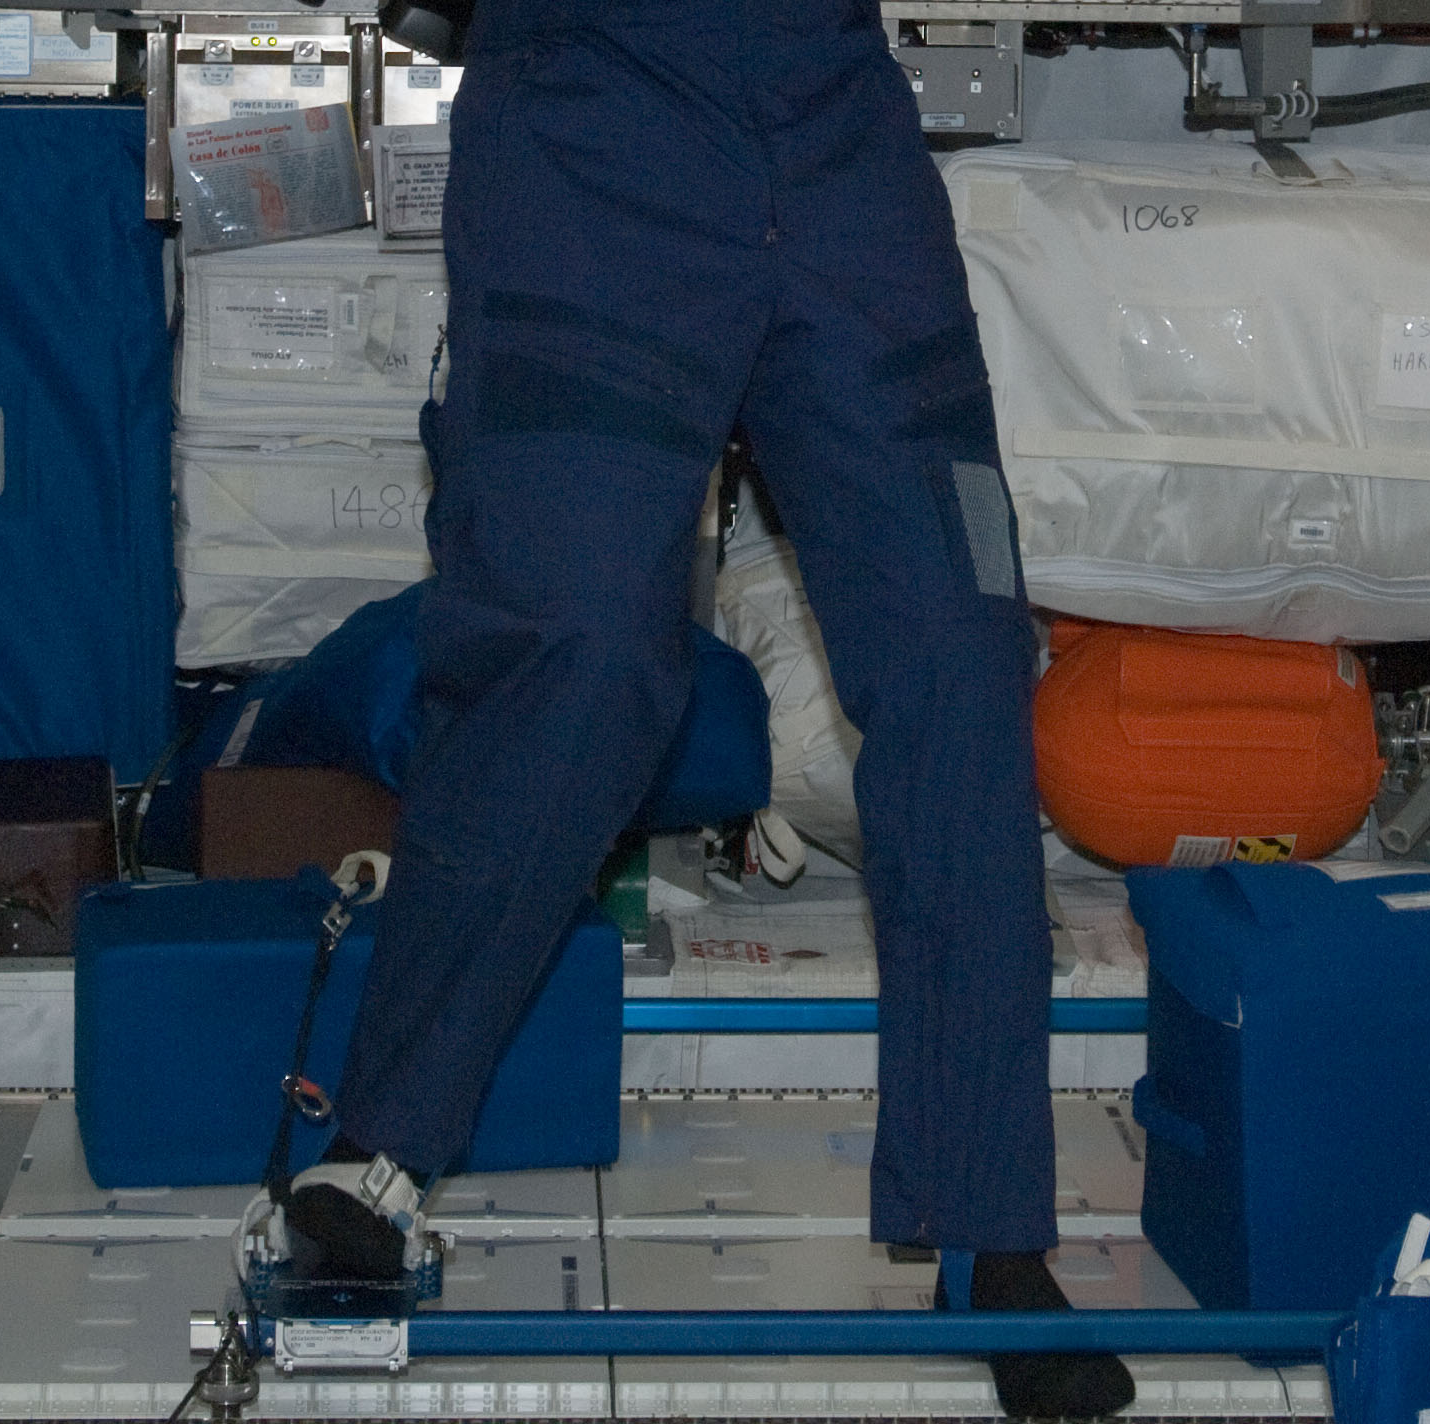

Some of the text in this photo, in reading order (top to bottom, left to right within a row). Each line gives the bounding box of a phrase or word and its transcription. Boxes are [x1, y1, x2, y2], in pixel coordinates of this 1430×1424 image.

[233, 101, 294, 109] POWER BUS #1
[245, 128, 262, 136] Gran
[189, 152, 213, 163] Casa
[216, 147, 227, 158] de
[1123, 205, 1200, 233] 1068
[274, 351, 292, 361] ATV
